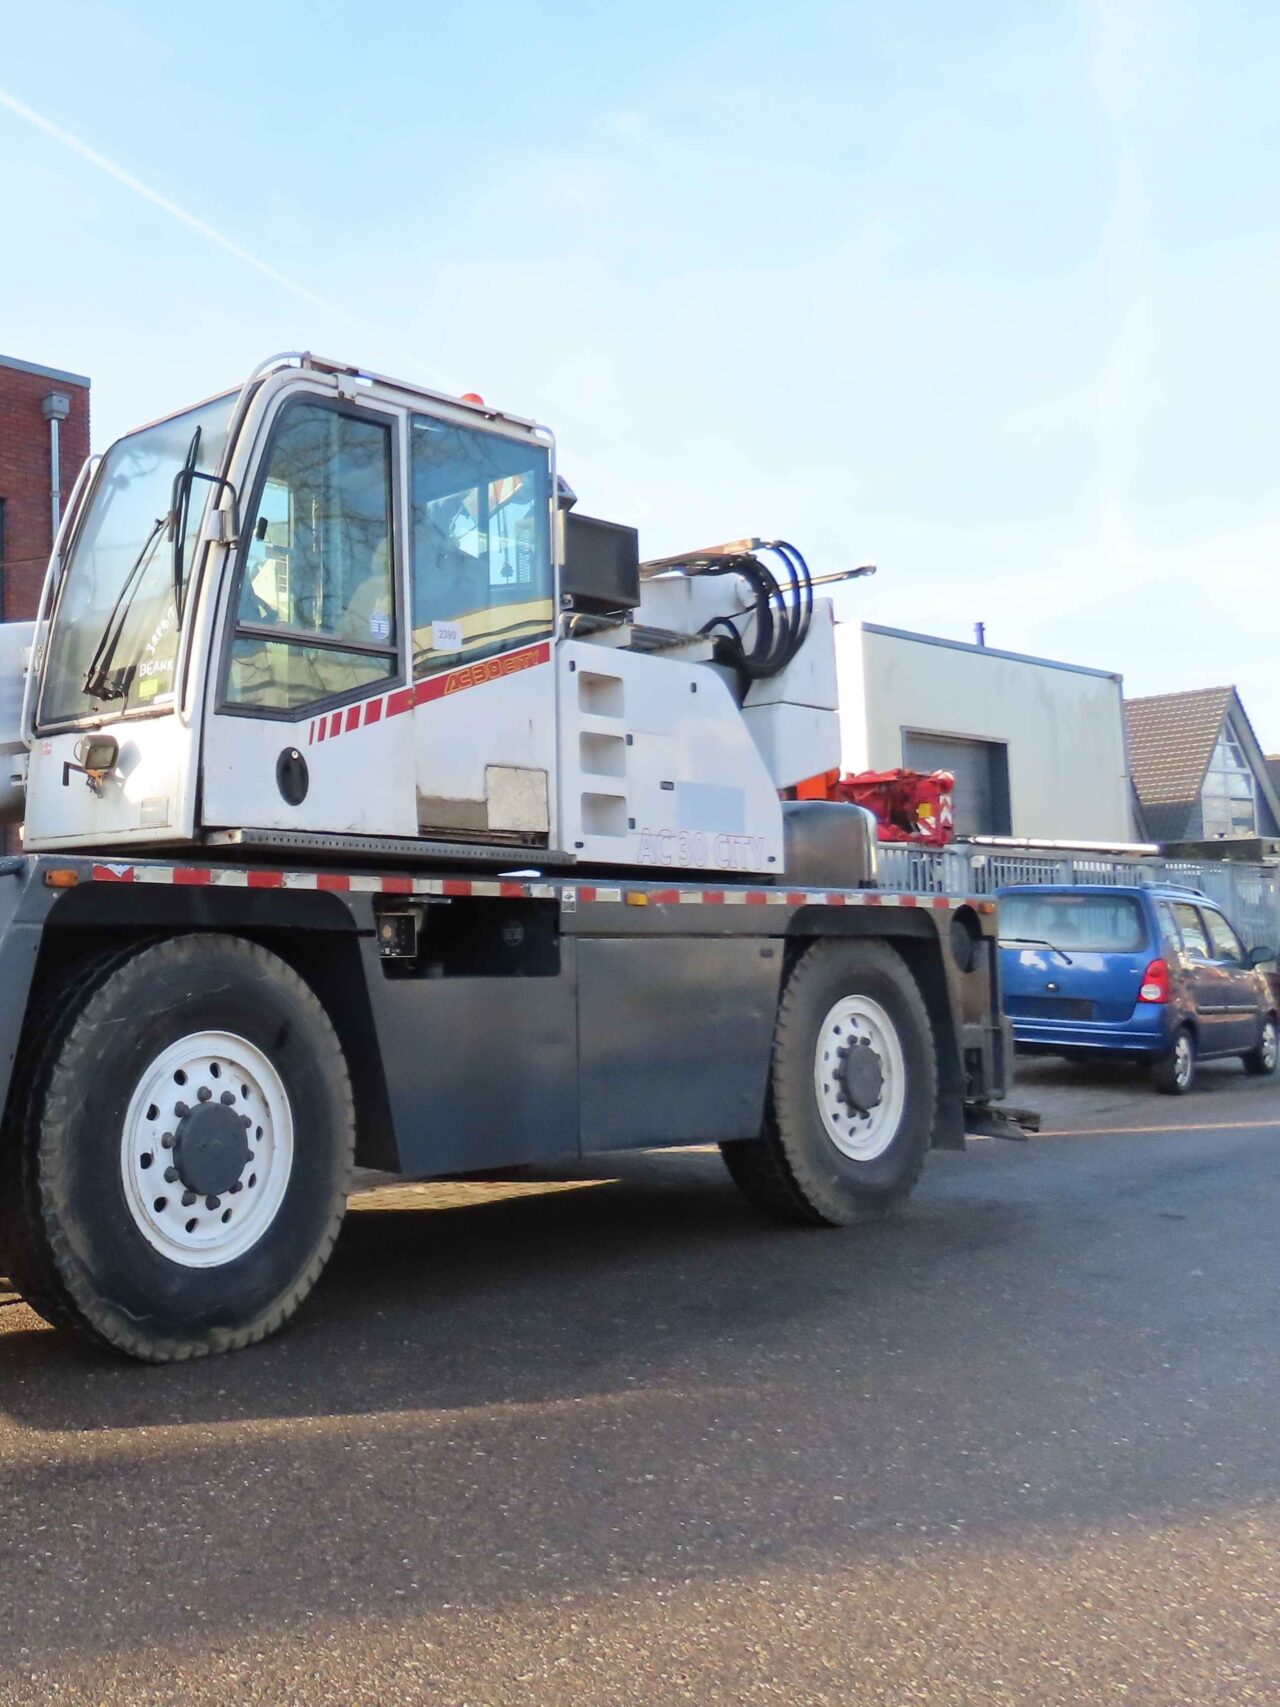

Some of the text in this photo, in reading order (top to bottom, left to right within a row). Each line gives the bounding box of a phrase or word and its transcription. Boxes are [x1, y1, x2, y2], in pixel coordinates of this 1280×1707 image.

[637, 827, 766, 871] AC 30 CITY
